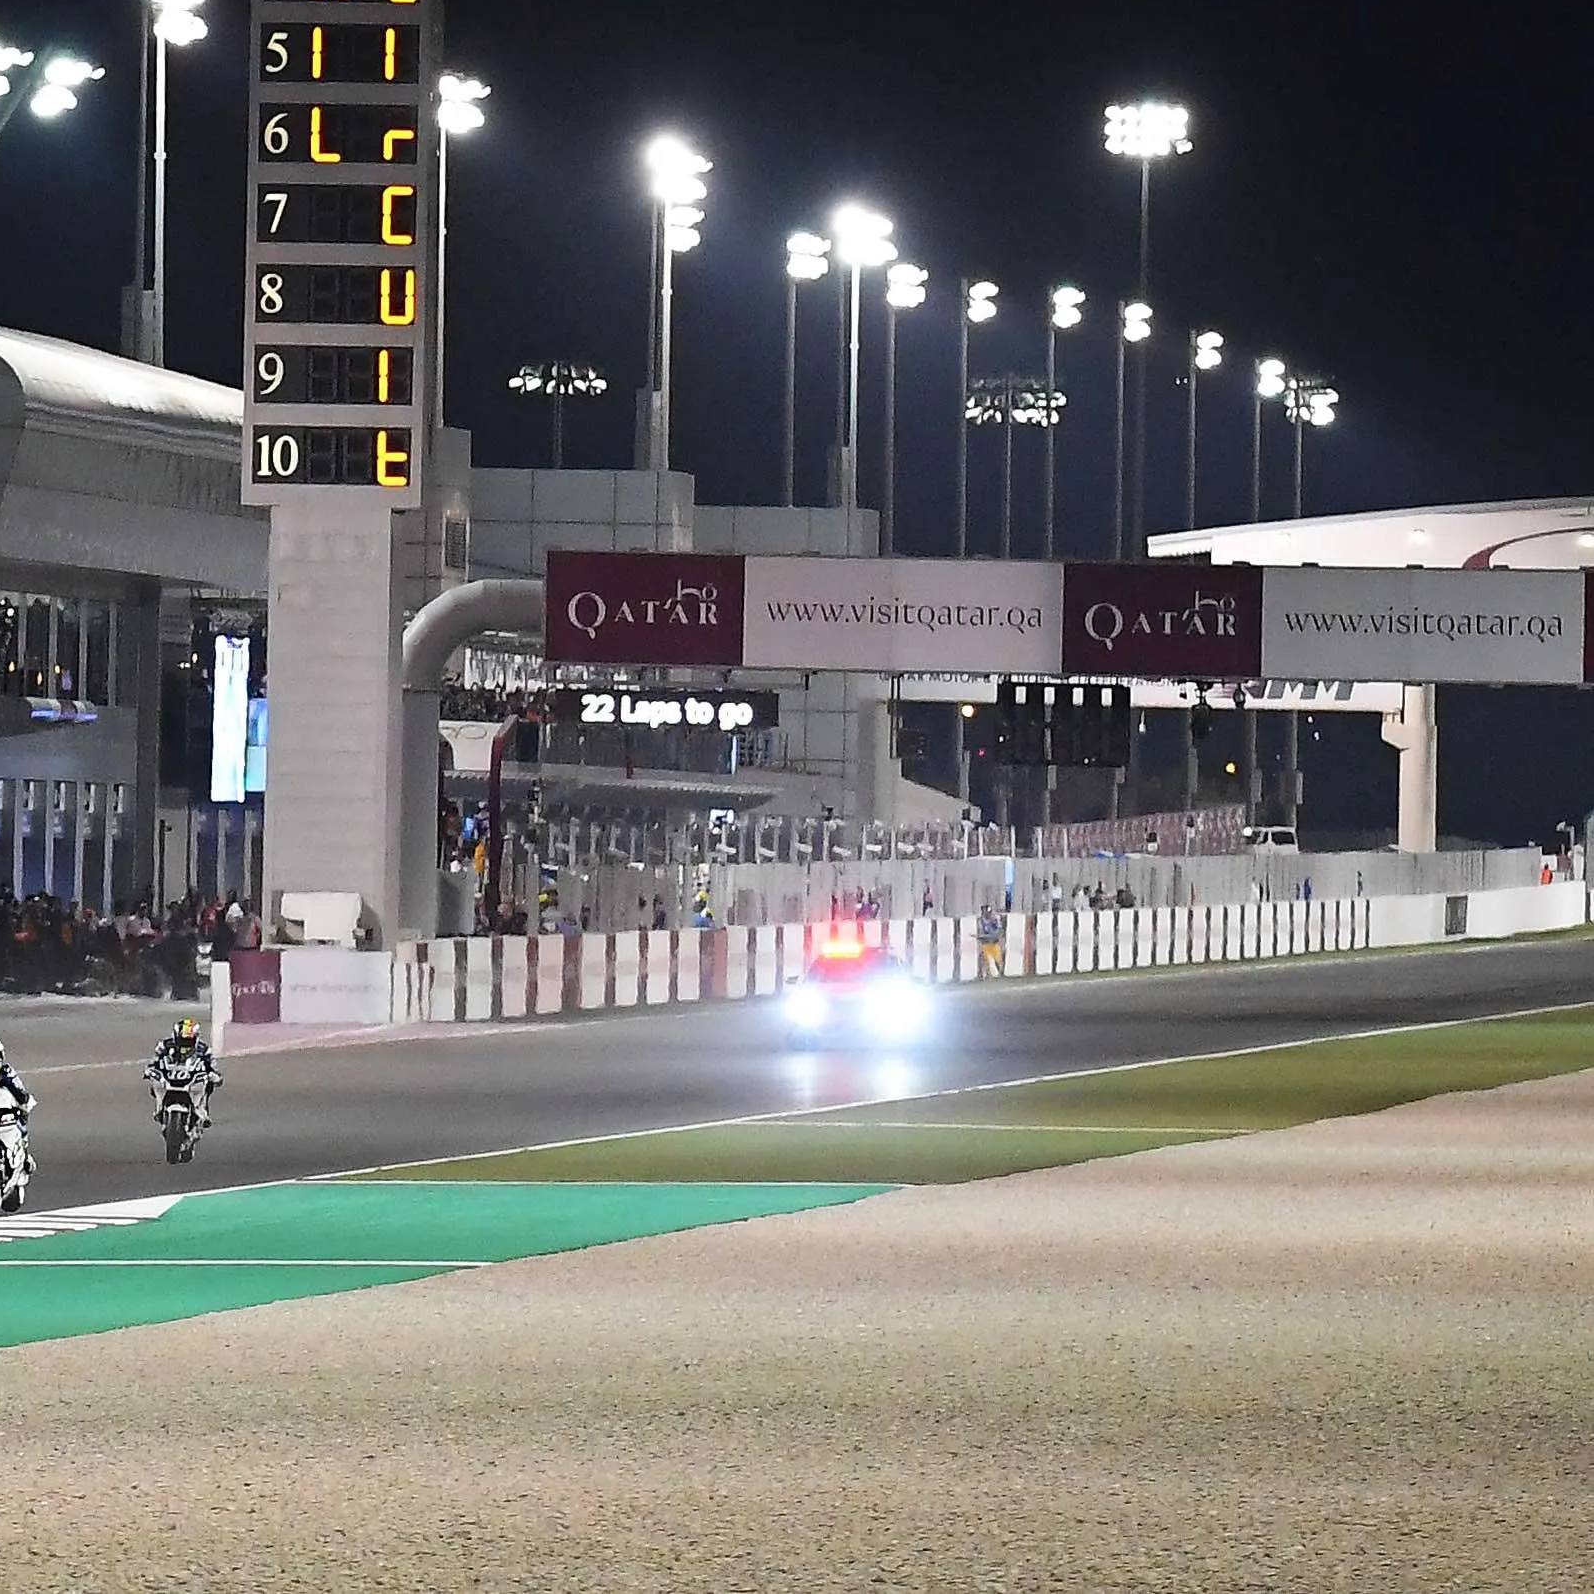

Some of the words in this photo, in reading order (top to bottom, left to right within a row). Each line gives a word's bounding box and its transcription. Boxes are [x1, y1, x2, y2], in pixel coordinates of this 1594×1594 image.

[265, 32, 289, 73] 5
[264, 112, 289, 154] 6
[310, 107, 341, 163] L
[263, 193, 288, 234] 7
[381, 186, 414, 245] C
[260, 273, 283, 314] 8
[380, 268, 415, 325] U
[258, 352, 284, 395] 9
[256, 434, 299, 477] 10
[568, 582, 718, 639] QATAR
[767, 596, 1043, 633] www.visitqatar.qa
[1085, 593, 1236, 650] QATAR
[1284, 607, 1563, 642] www.visitqatar.qa
[581, 694, 615, 723] 22
[621, 695, 682, 729] Laps
[685, 697, 715, 725] to
[718, 702, 754, 731] go
